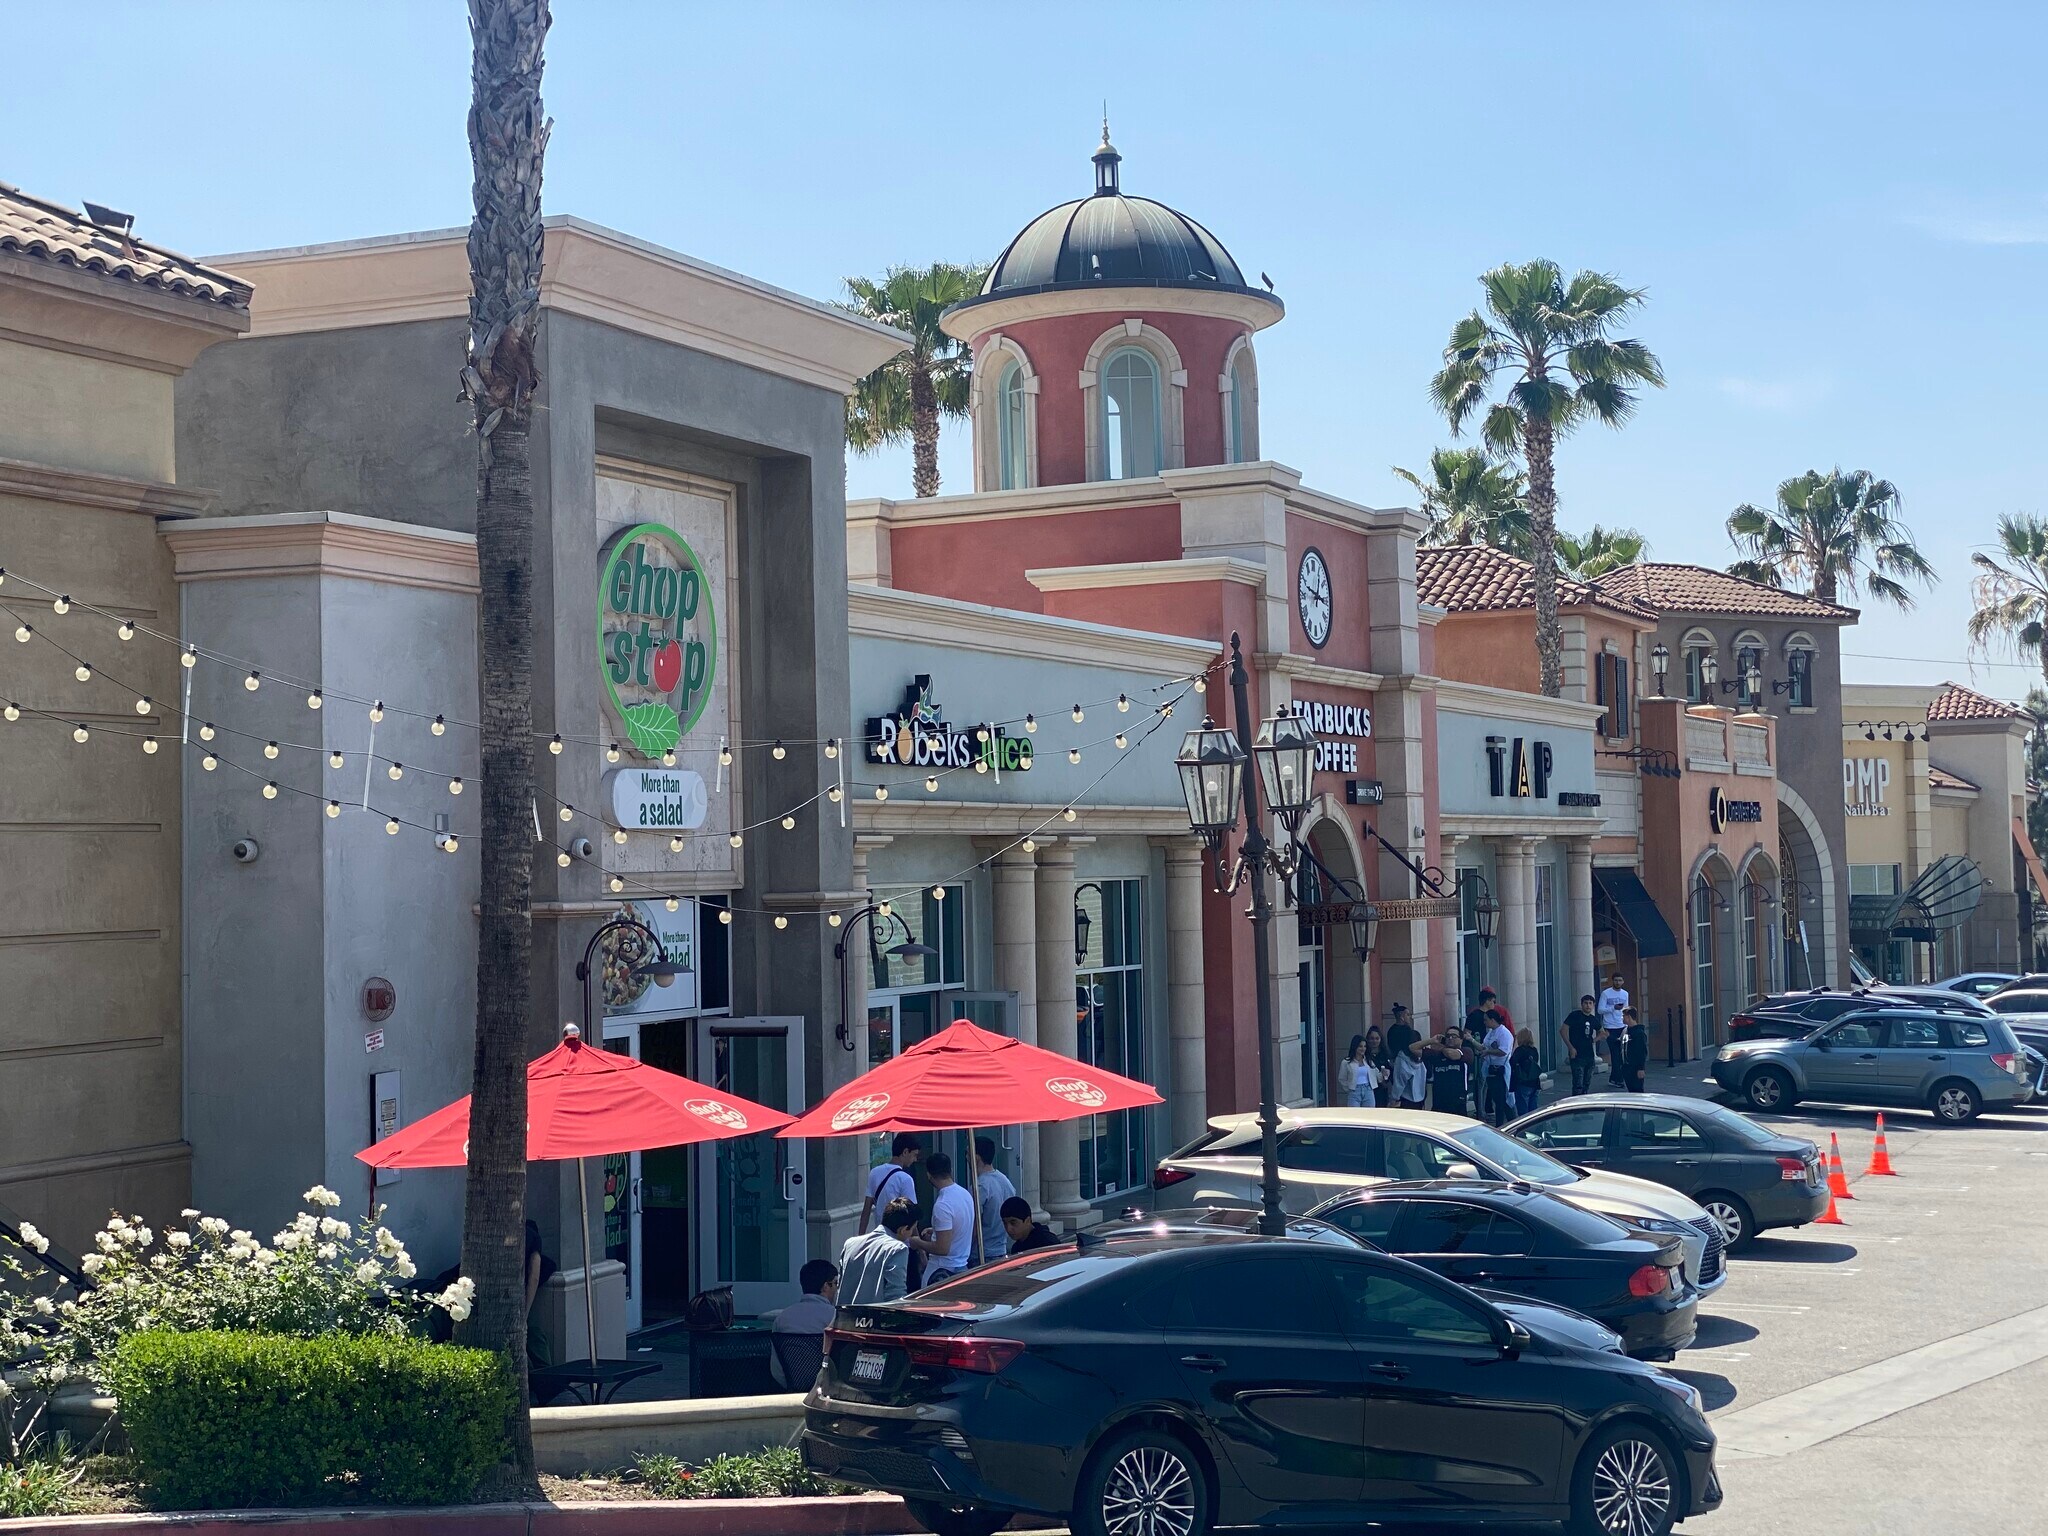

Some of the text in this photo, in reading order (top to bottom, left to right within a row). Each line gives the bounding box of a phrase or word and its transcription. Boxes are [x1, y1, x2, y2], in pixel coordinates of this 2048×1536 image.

[610, 543, 701, 639] chop
[611, 622, 706, 711] stop
[1293, 700, 1371, 738] TARBUCKS
[881, 718, 1033, 770] Robeks Juice
[1314, 741, 1358, 773] OFFEE
[1486, 736, 1553, 798] TAP
[641, 773, 680, 793] More than
[1843, 758, 1890, 803] PMP
[640, 795, 683, 826] a salad
[1844, 804, 1892, 817] Nail Bar
[662, 931, 675, 944] More
[675, 930, 686, 943] than
[1050, 1081, 1089, 1093] chop
[1064, 1090, 1103, 1102] stop
[689, 1101, 727, 1115] chop
[849, 1096, 888, 1111] chop
[855, 1317, 874, 1328] KIA
